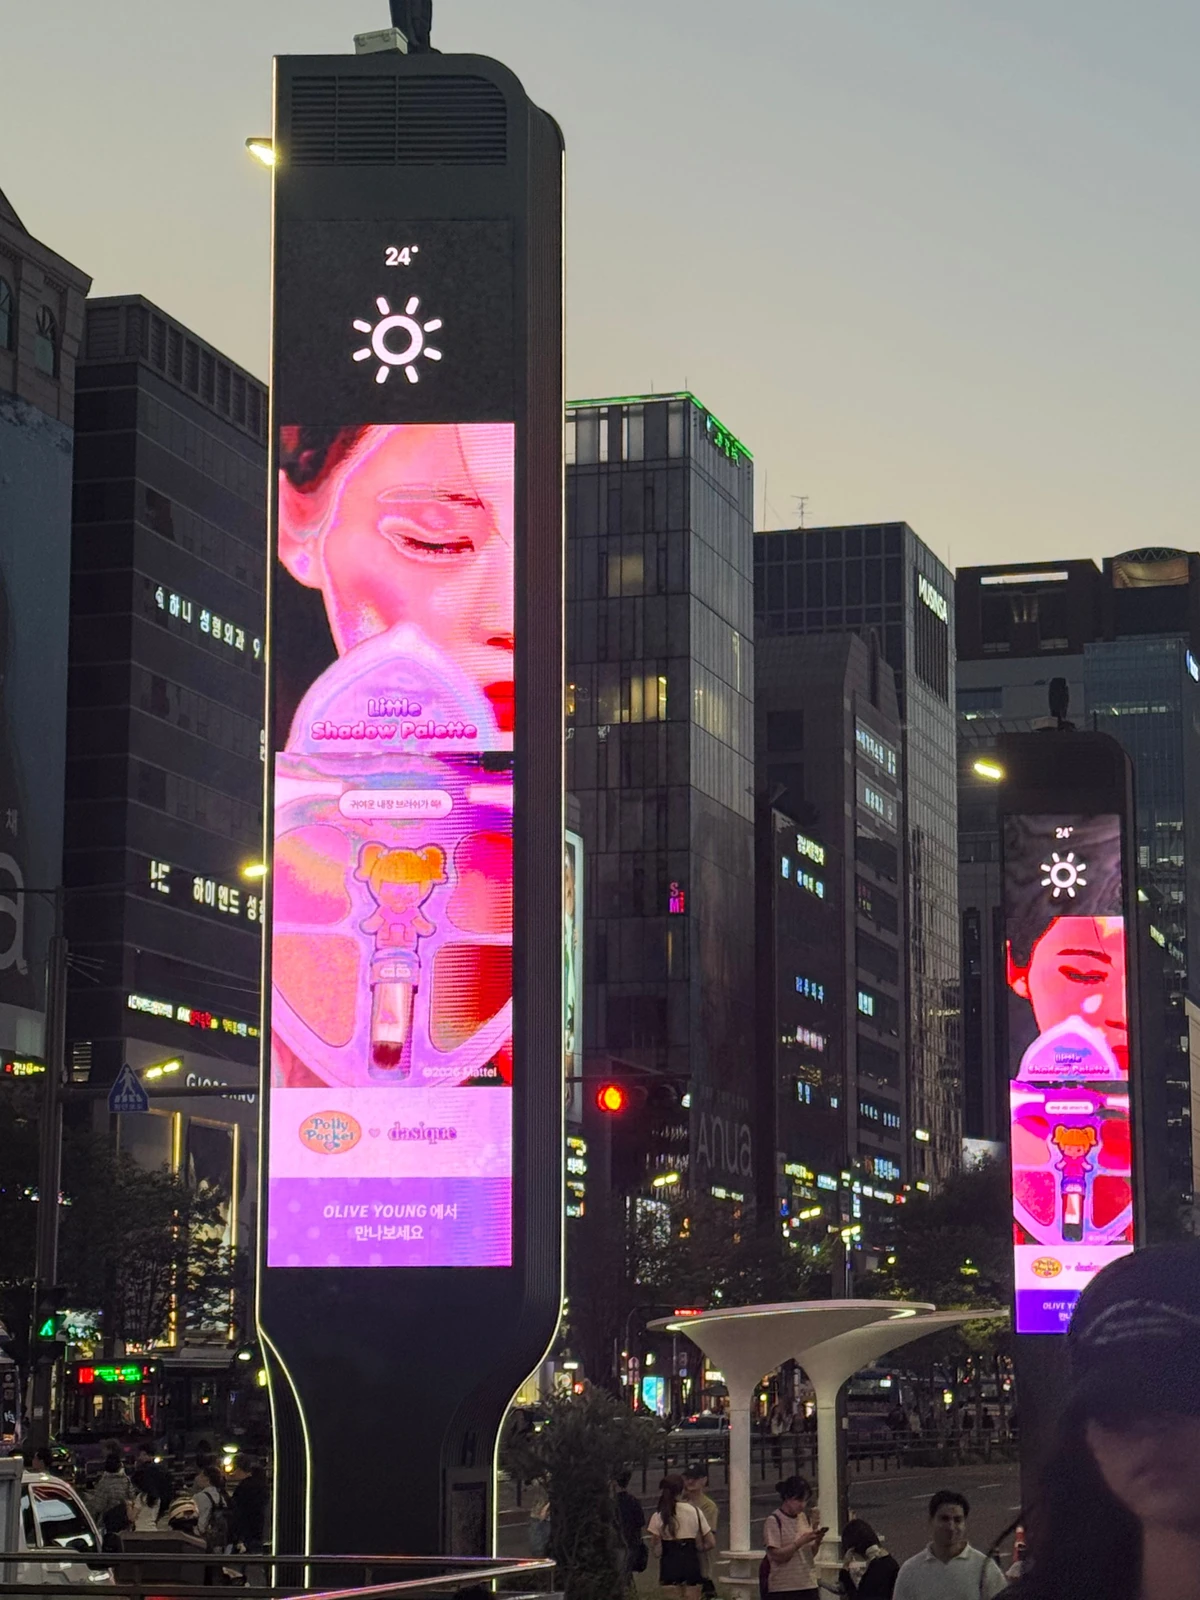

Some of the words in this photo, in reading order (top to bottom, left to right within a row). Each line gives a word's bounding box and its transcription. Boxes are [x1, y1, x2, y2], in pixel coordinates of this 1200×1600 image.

[200, 609, 245, 651] 성형외과
[367, 698, 422, 717] Little
[311, 720, 397, 740] Shadow
[400, 720, 478, 740] Palette
[349, 799, 375, 810] 귀여운
[376, 799, 395, 810] 내장
[193, 877, 240, 914] 하이엔드
[311, 1117, 349, 1132] Polly
[388, 1121, 458, 1144] dasique
[304, 1130, 354, 1143] Pocket
[323, 1205, 369, 1219] OLIVE
[374, 1205, 428, 1219] YOUNG
[429, 1203, 458, 1220] 에서
[354, 1225, 425, 1241] 만나보세요
